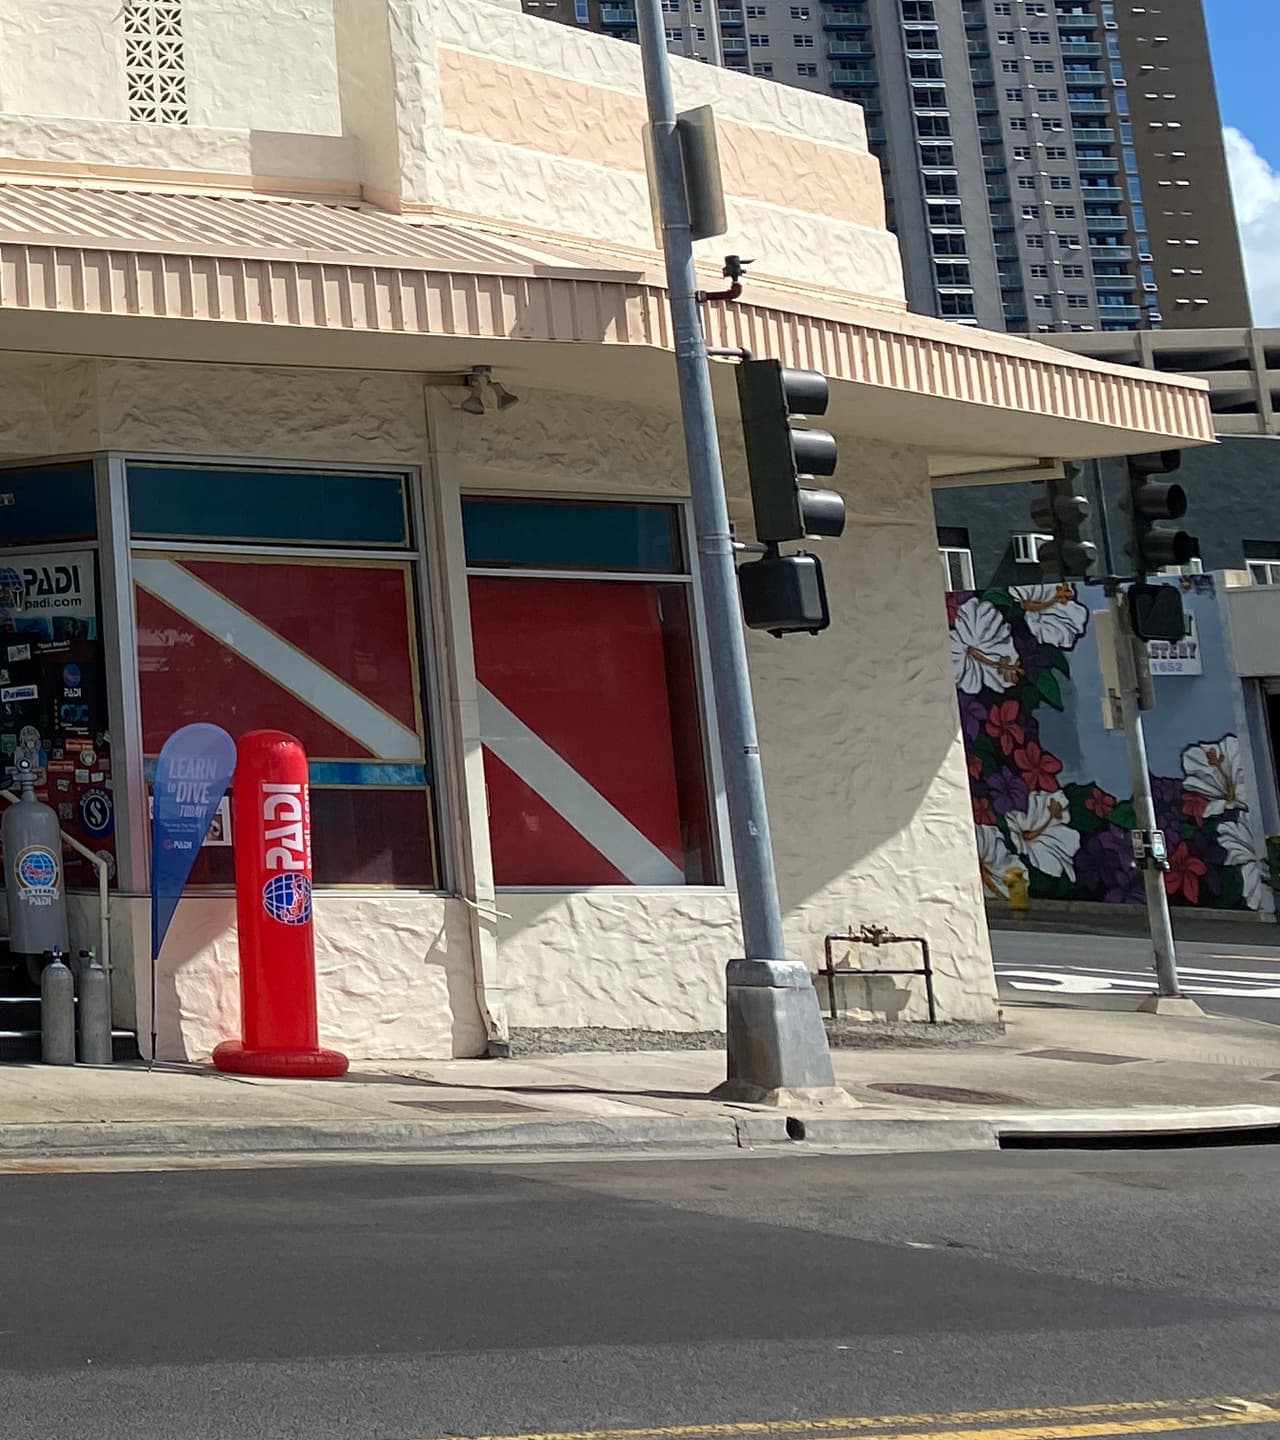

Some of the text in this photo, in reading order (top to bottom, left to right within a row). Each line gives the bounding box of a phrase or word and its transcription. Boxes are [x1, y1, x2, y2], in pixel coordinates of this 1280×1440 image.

[22, 565, 81, 596] PADI
[24, 597, 82, 611] padi.com
[168, 758, 217, 779] LEARN
[176, 782, 212, 804] DIVE
[261, 783, 305, 870] PADI
[173, 840, 193, 849] PADI
